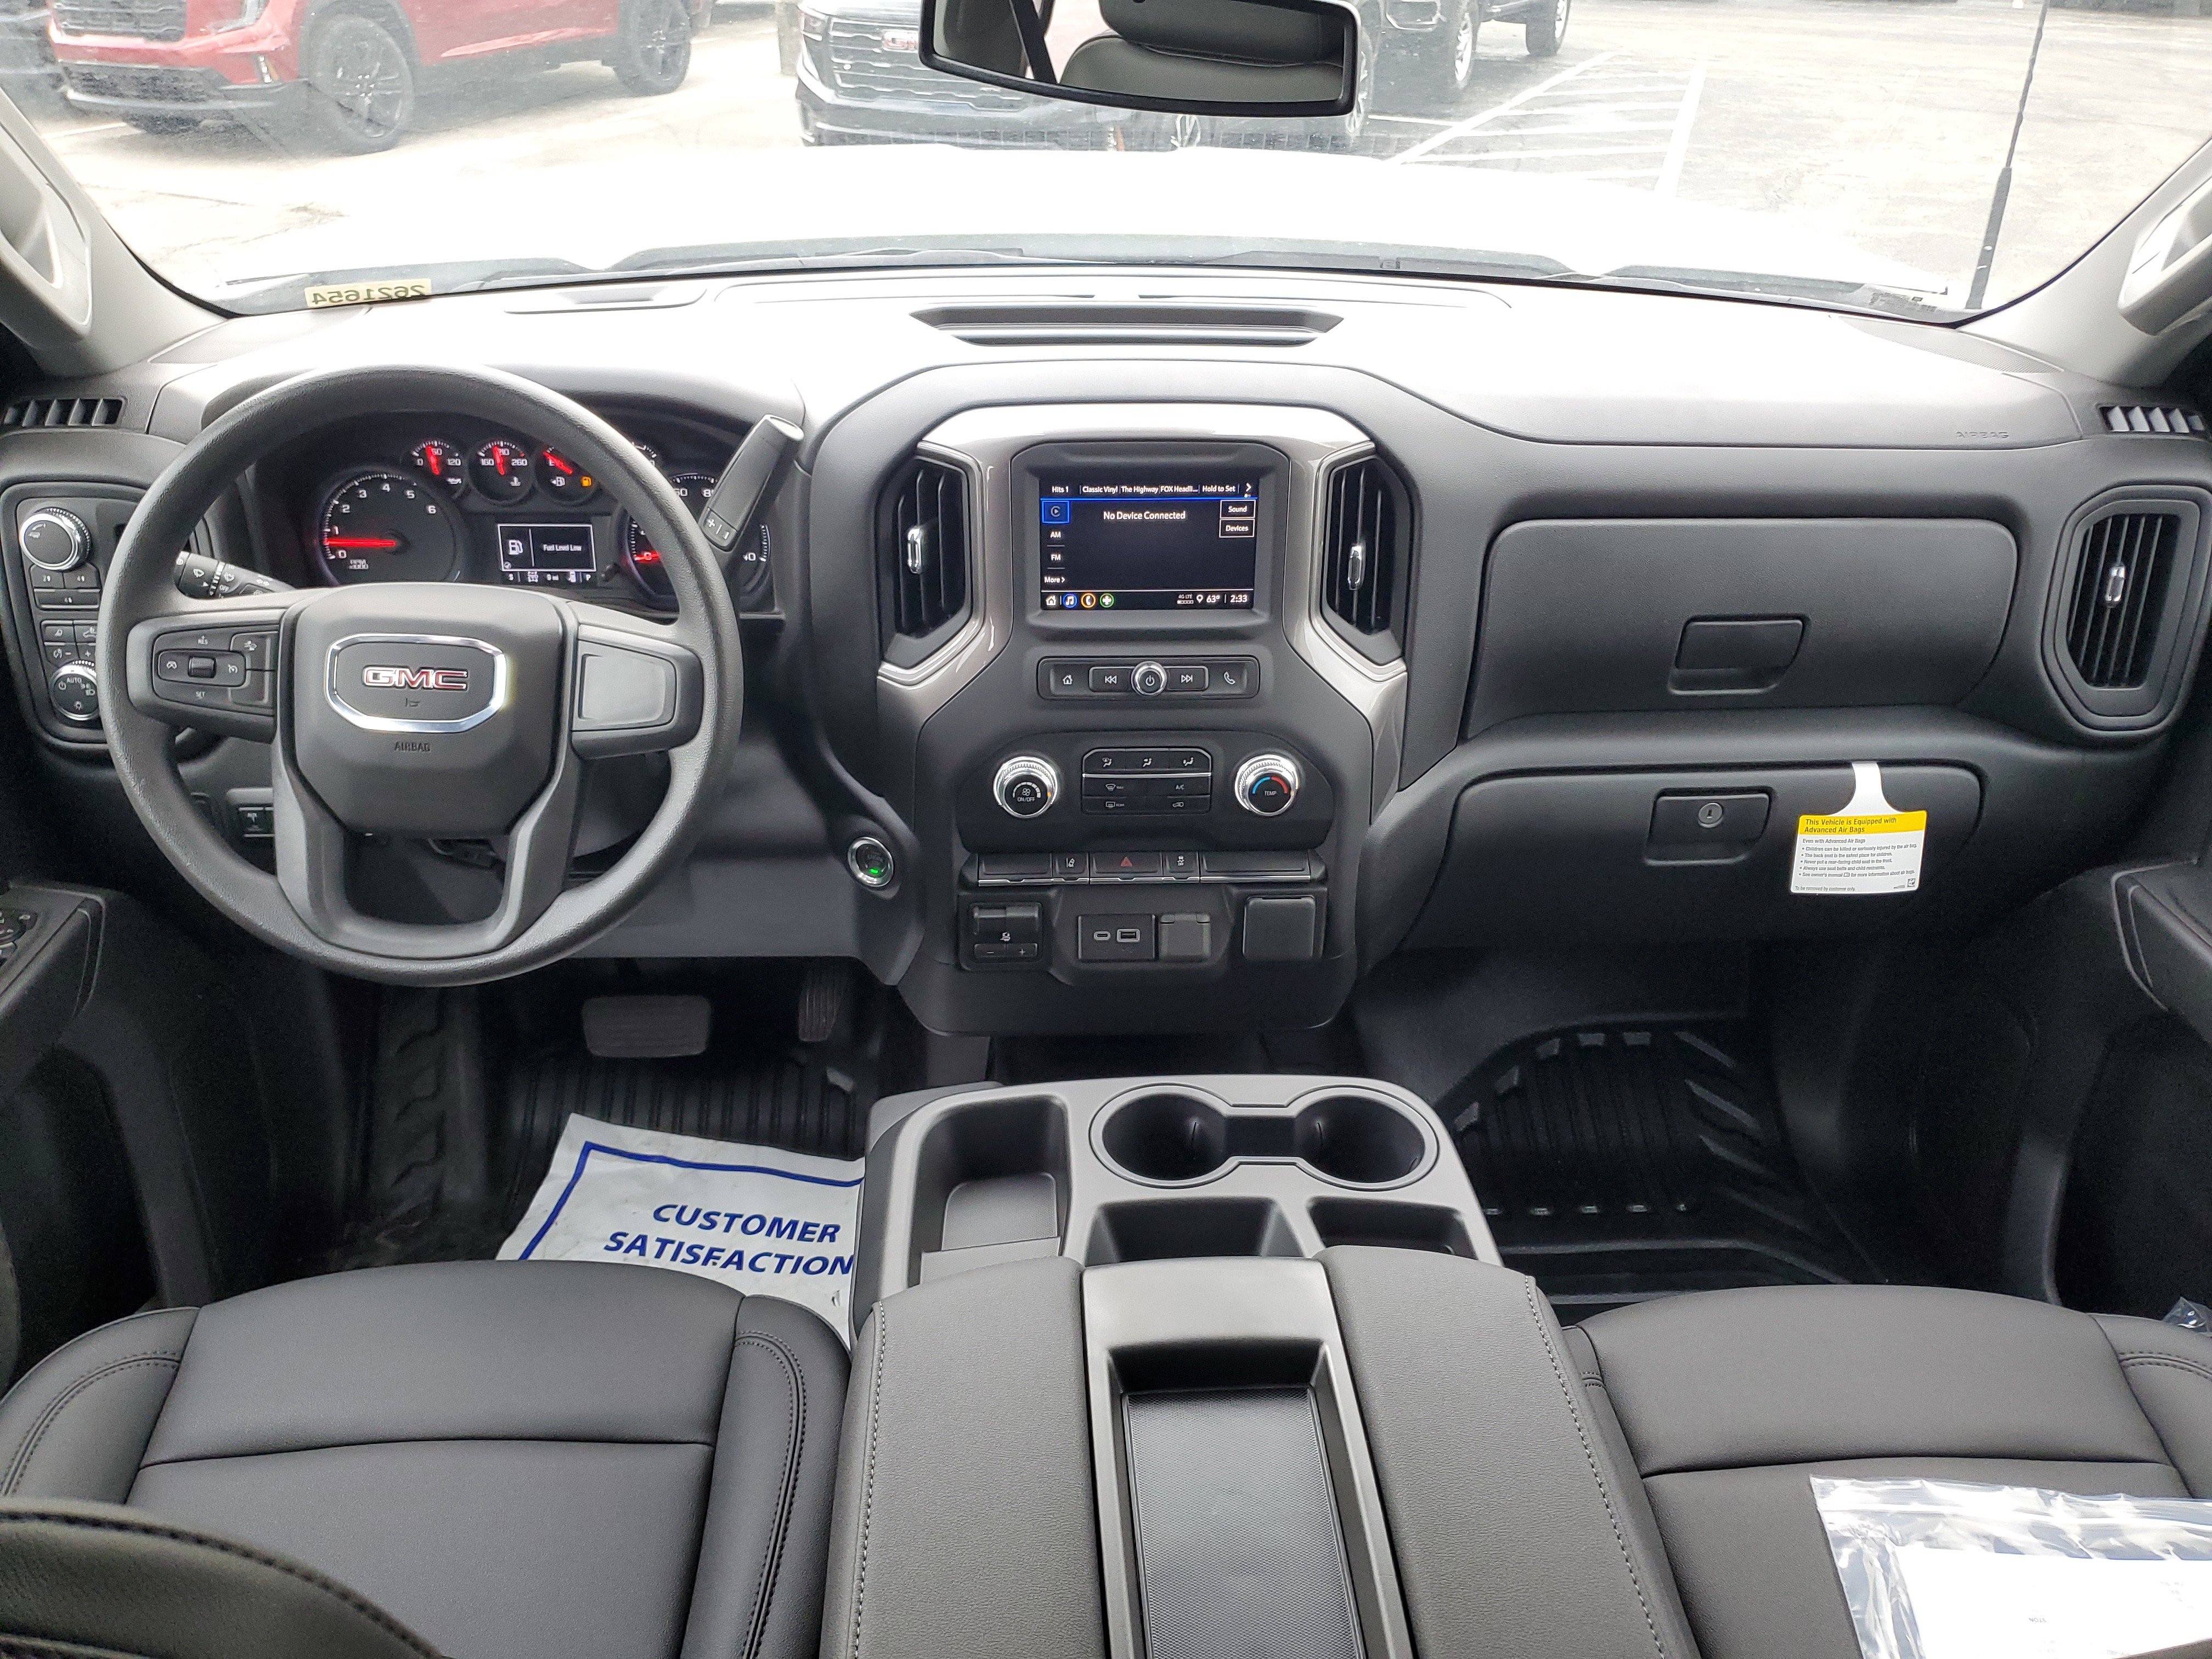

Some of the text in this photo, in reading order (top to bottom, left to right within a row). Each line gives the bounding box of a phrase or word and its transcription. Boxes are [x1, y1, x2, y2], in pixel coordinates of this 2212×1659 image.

[382, 483, 390, 492] 4
[358, 489, 367, 498] 3
[406, 489, 415, 499] 5
[342, 504, 350, 513] 2
[427, 505, 436, 514] 6
[1103, 510, 1186, 520] No Device Connected
[334, 526, 339, 535] 1
[337, 550, 347, 558] 0
[1230, 595, 1248, 603] 2:33
[363, 666, 467, 690] GMC
[394, 742, 430, 752] AIRBAG
[1853, 818, 1882, 826] Equipped
[653, 1204, 840, 1243] CUSTOMER
[603, 1231, 854, 1276] SATISFACTION
